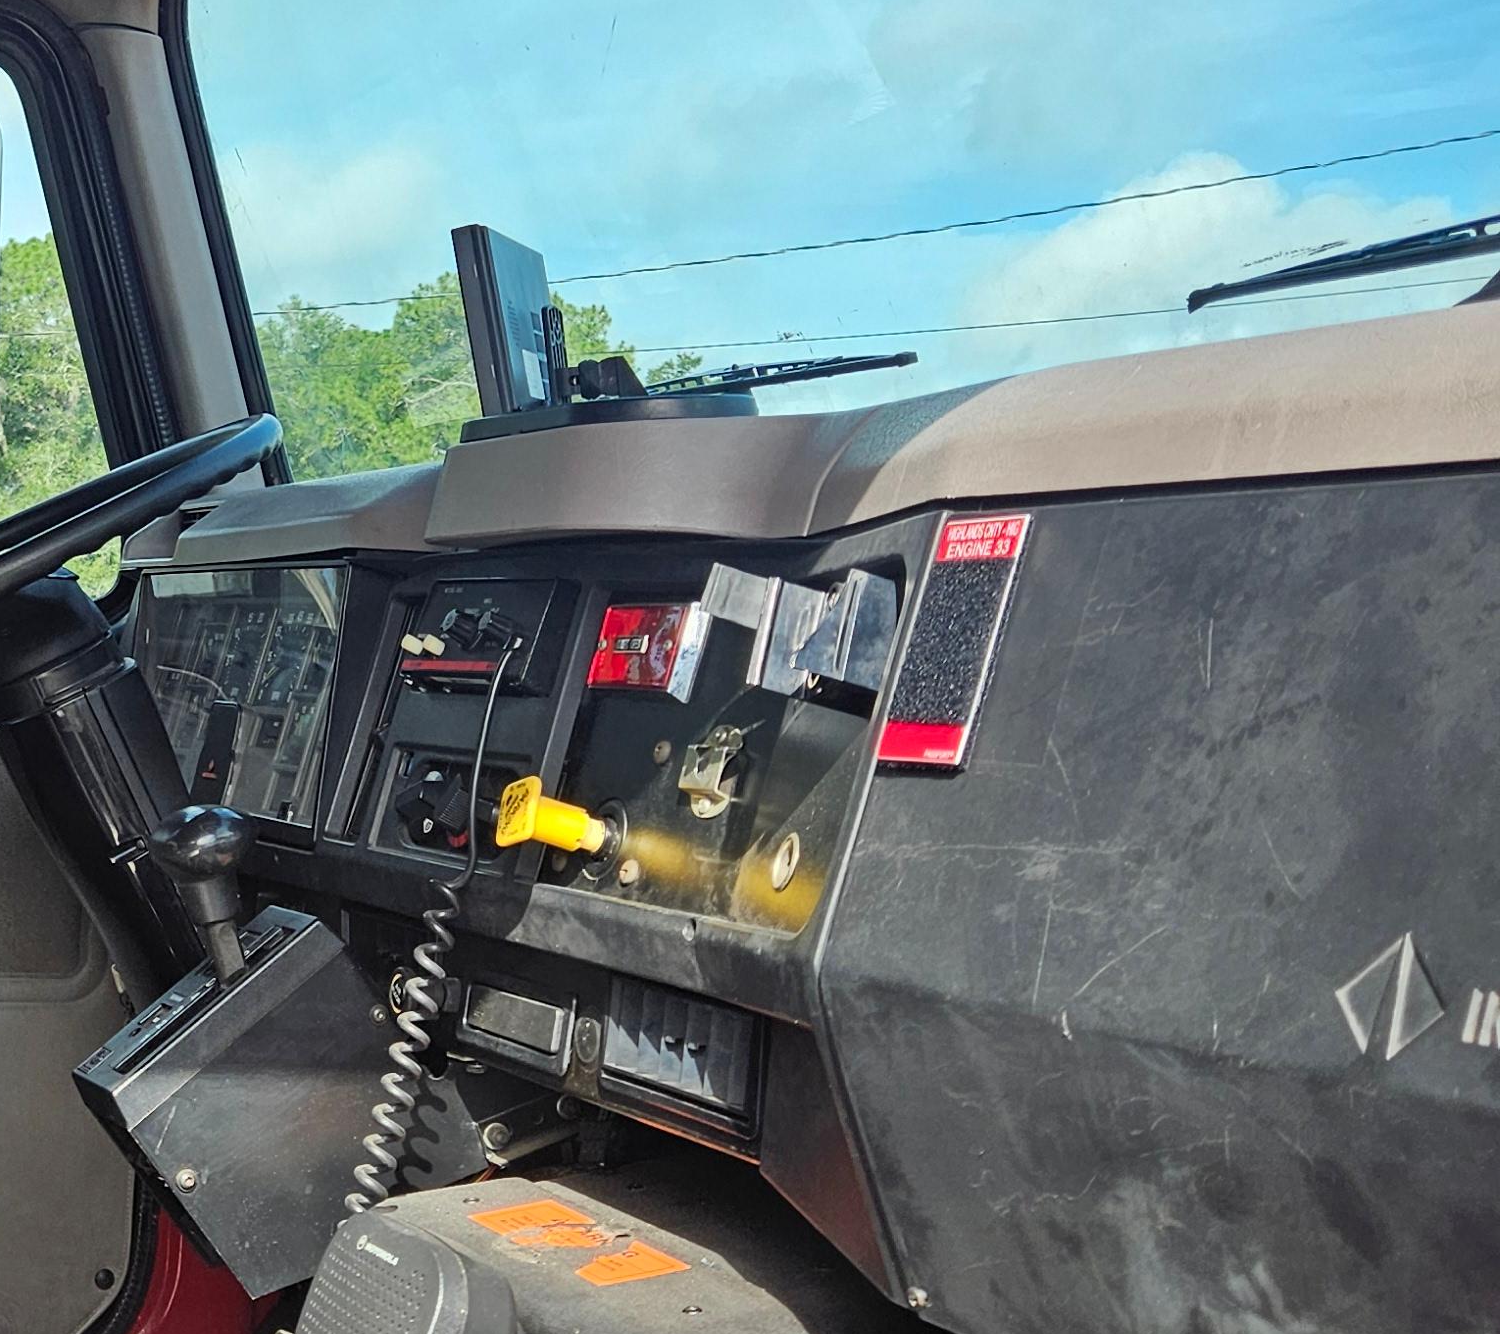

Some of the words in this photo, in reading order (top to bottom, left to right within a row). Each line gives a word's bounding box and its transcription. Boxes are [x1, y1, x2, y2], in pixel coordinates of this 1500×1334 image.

[947, 524, 984, 541] HIGHLANDS
[945, 540, 994, 559] ENGINE
[994, 538, 1012, 556] 33
